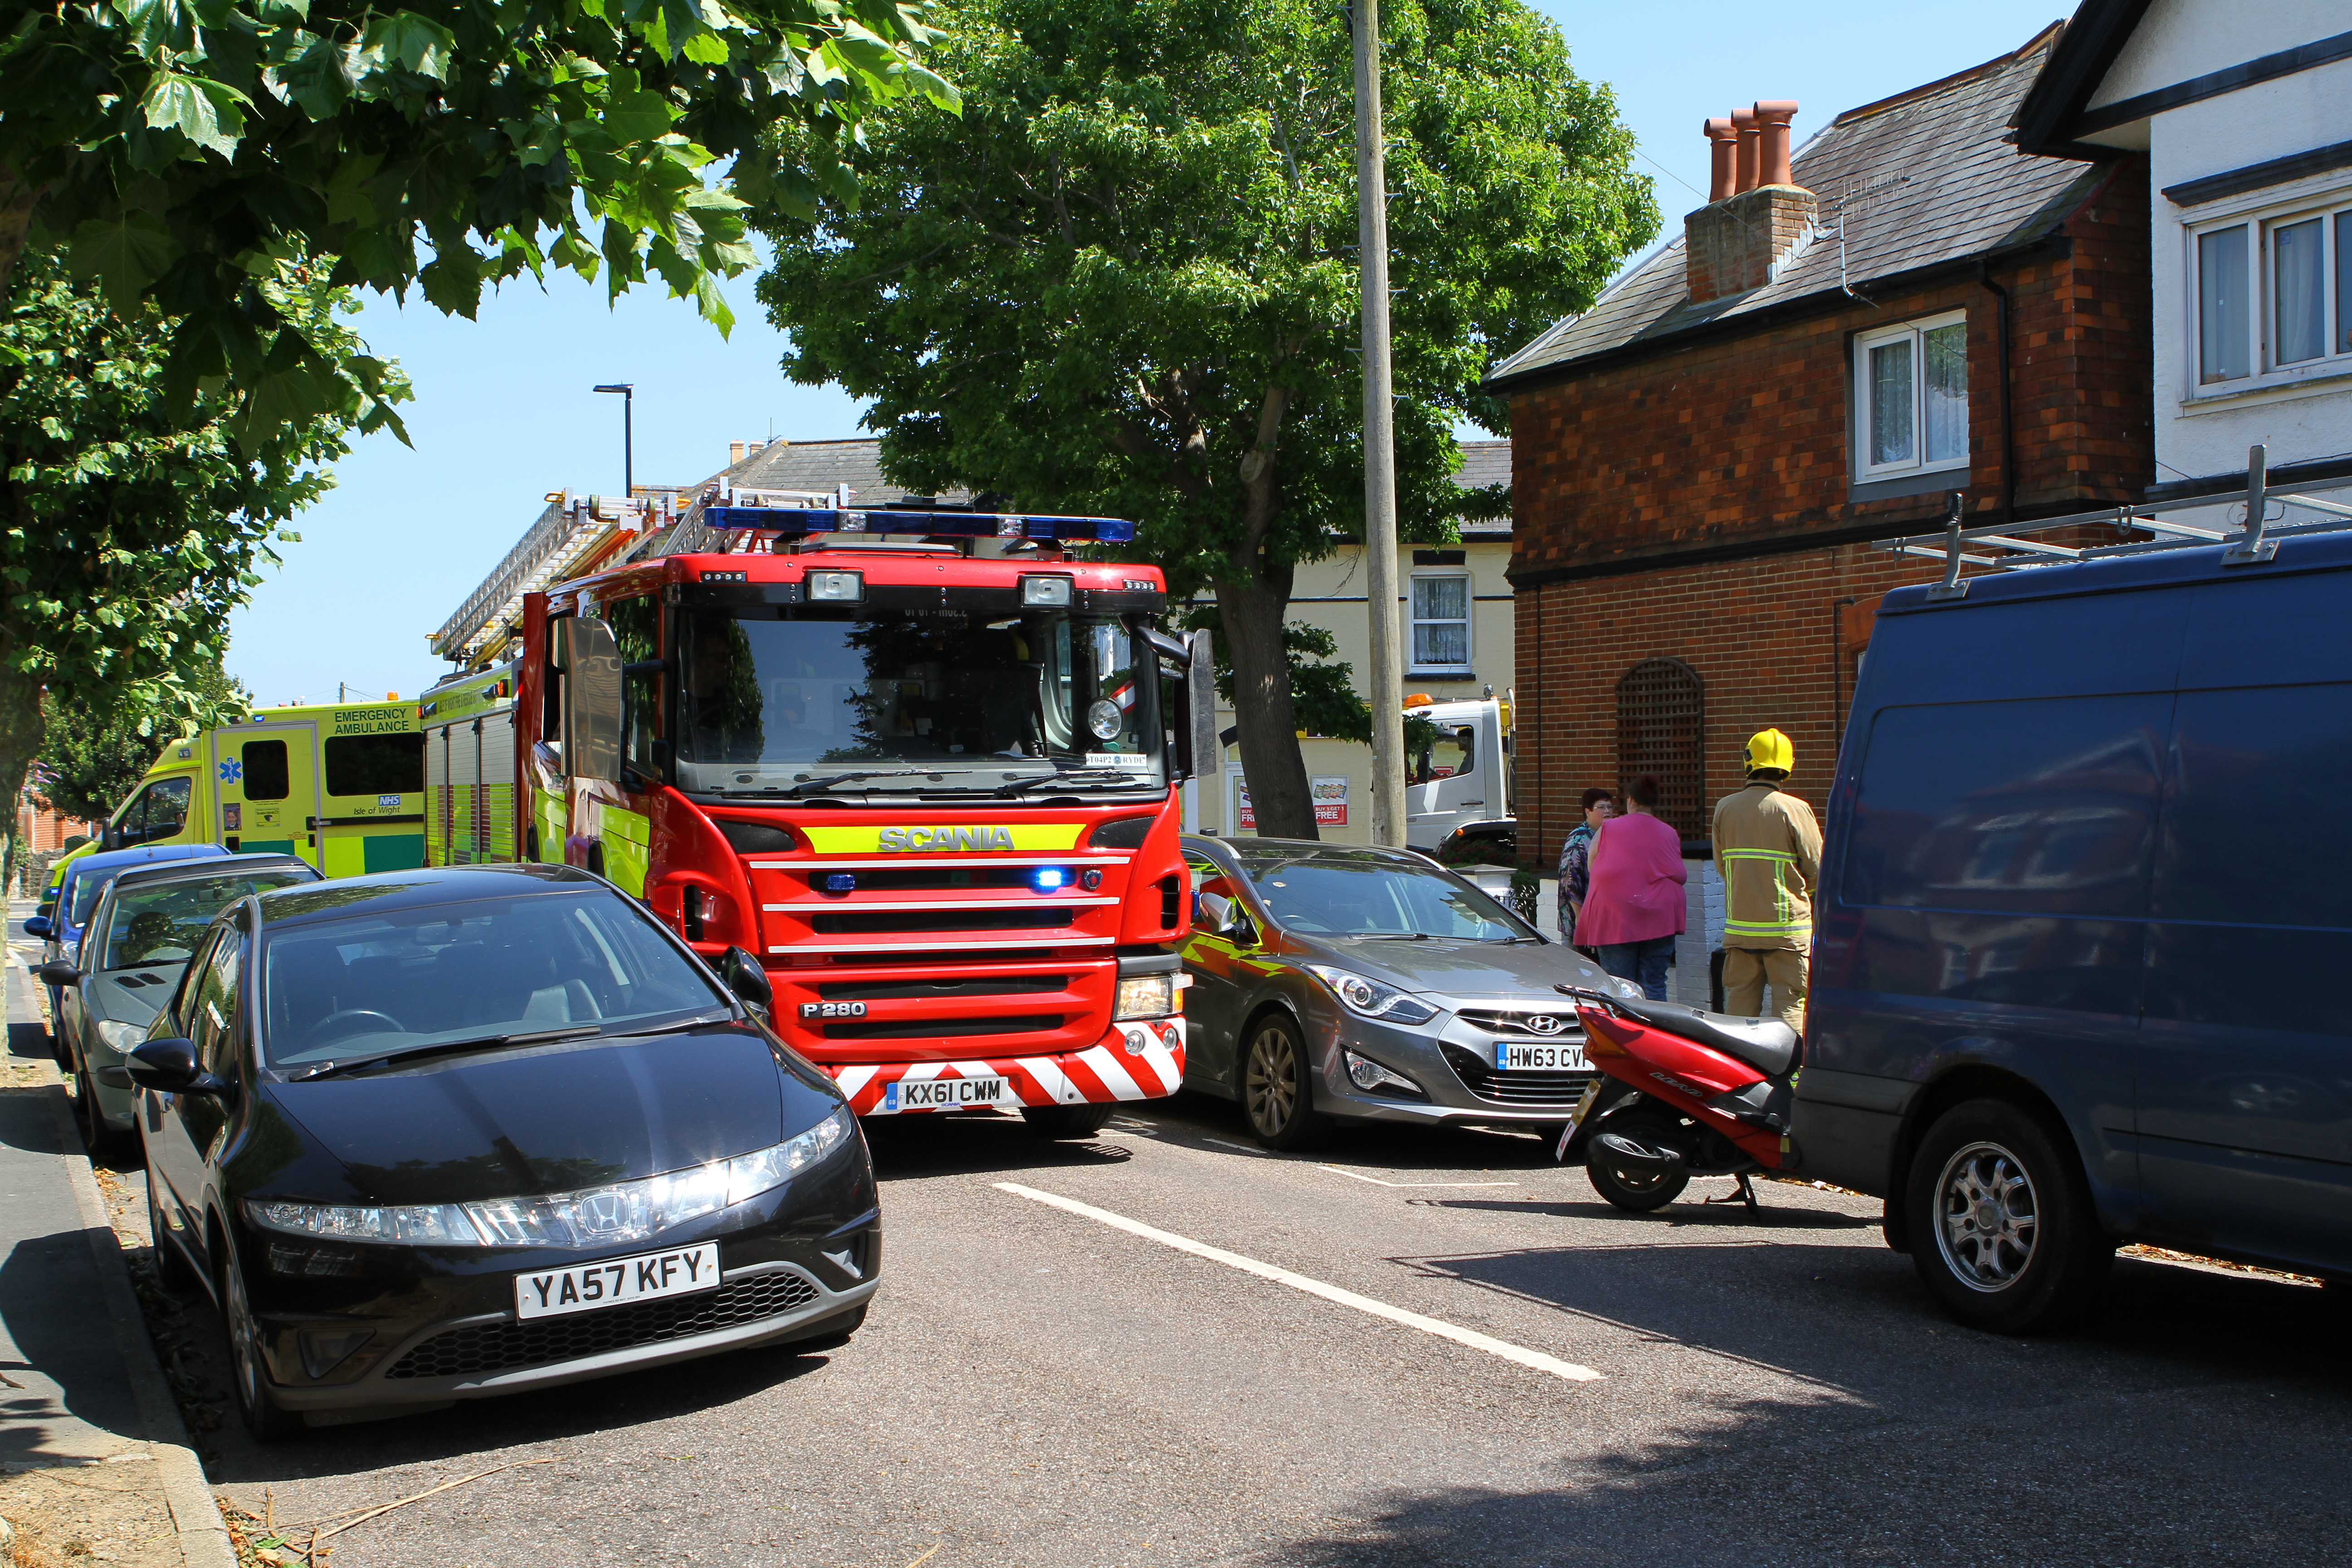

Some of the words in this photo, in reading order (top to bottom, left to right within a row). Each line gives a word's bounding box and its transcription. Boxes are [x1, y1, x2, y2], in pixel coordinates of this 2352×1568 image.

[335, 708, 407, 722] EMERGENCY
[335, 720, 409, 735] AMBULANCE
[379, 795, 399, 805] NHS
[378, 806, 401, 815] Wight
[1316, 811, 1338, 819] FREE
[879, 827, 1015, 851] SCANIA
[804, 1004, 818, 1017] P
[822, 1003, 865, 1016] 280
[1510, 1048, 1555, 1067] HW63
[906, 1083, 953, 1104] KX61
[960, 1080, 1000, 1101] CWM
[1649, 1072, 1703, 1097] LEAD
[533, 1264, 626, 1308] YA57
[637, 1250, 702, 1292] KFY
